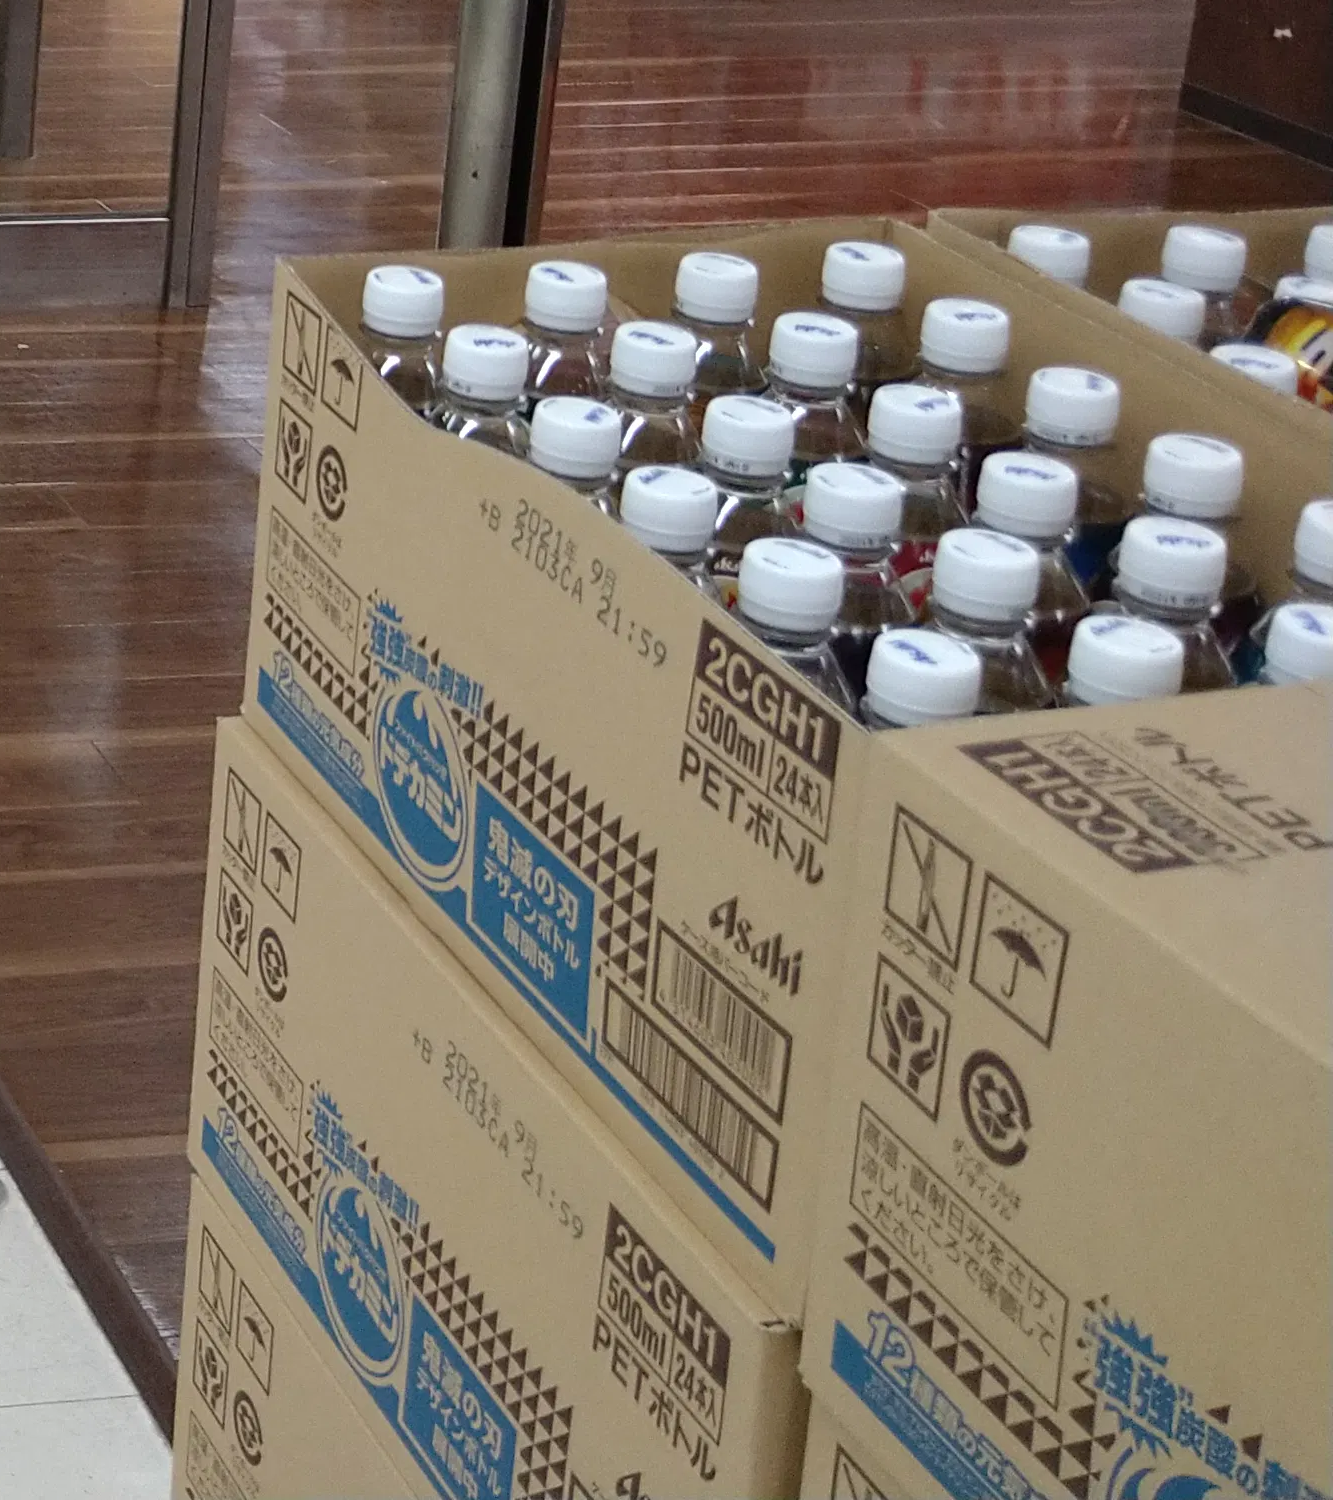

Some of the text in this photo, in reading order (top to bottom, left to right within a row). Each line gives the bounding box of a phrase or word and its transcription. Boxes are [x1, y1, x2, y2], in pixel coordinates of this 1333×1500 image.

[597, 605, 668, 668] 21:59
[705, 637, 827, 763] 2CGH1
[678, 748, 824, 886] PETボトル
[695, 696, 826, 826] 500ml 24本入
[482, 857, 580, 969] デザインボトル
[488, 818, 580, 932] 鬼滅の刃
[708, 895, 804, 997] Asahi
[606, 1274, 718, 1427] 500ml 24本入
[613, 1223, 719, 1372] 2CGH1
[593, 1313, 716, 1482] PETボトル
